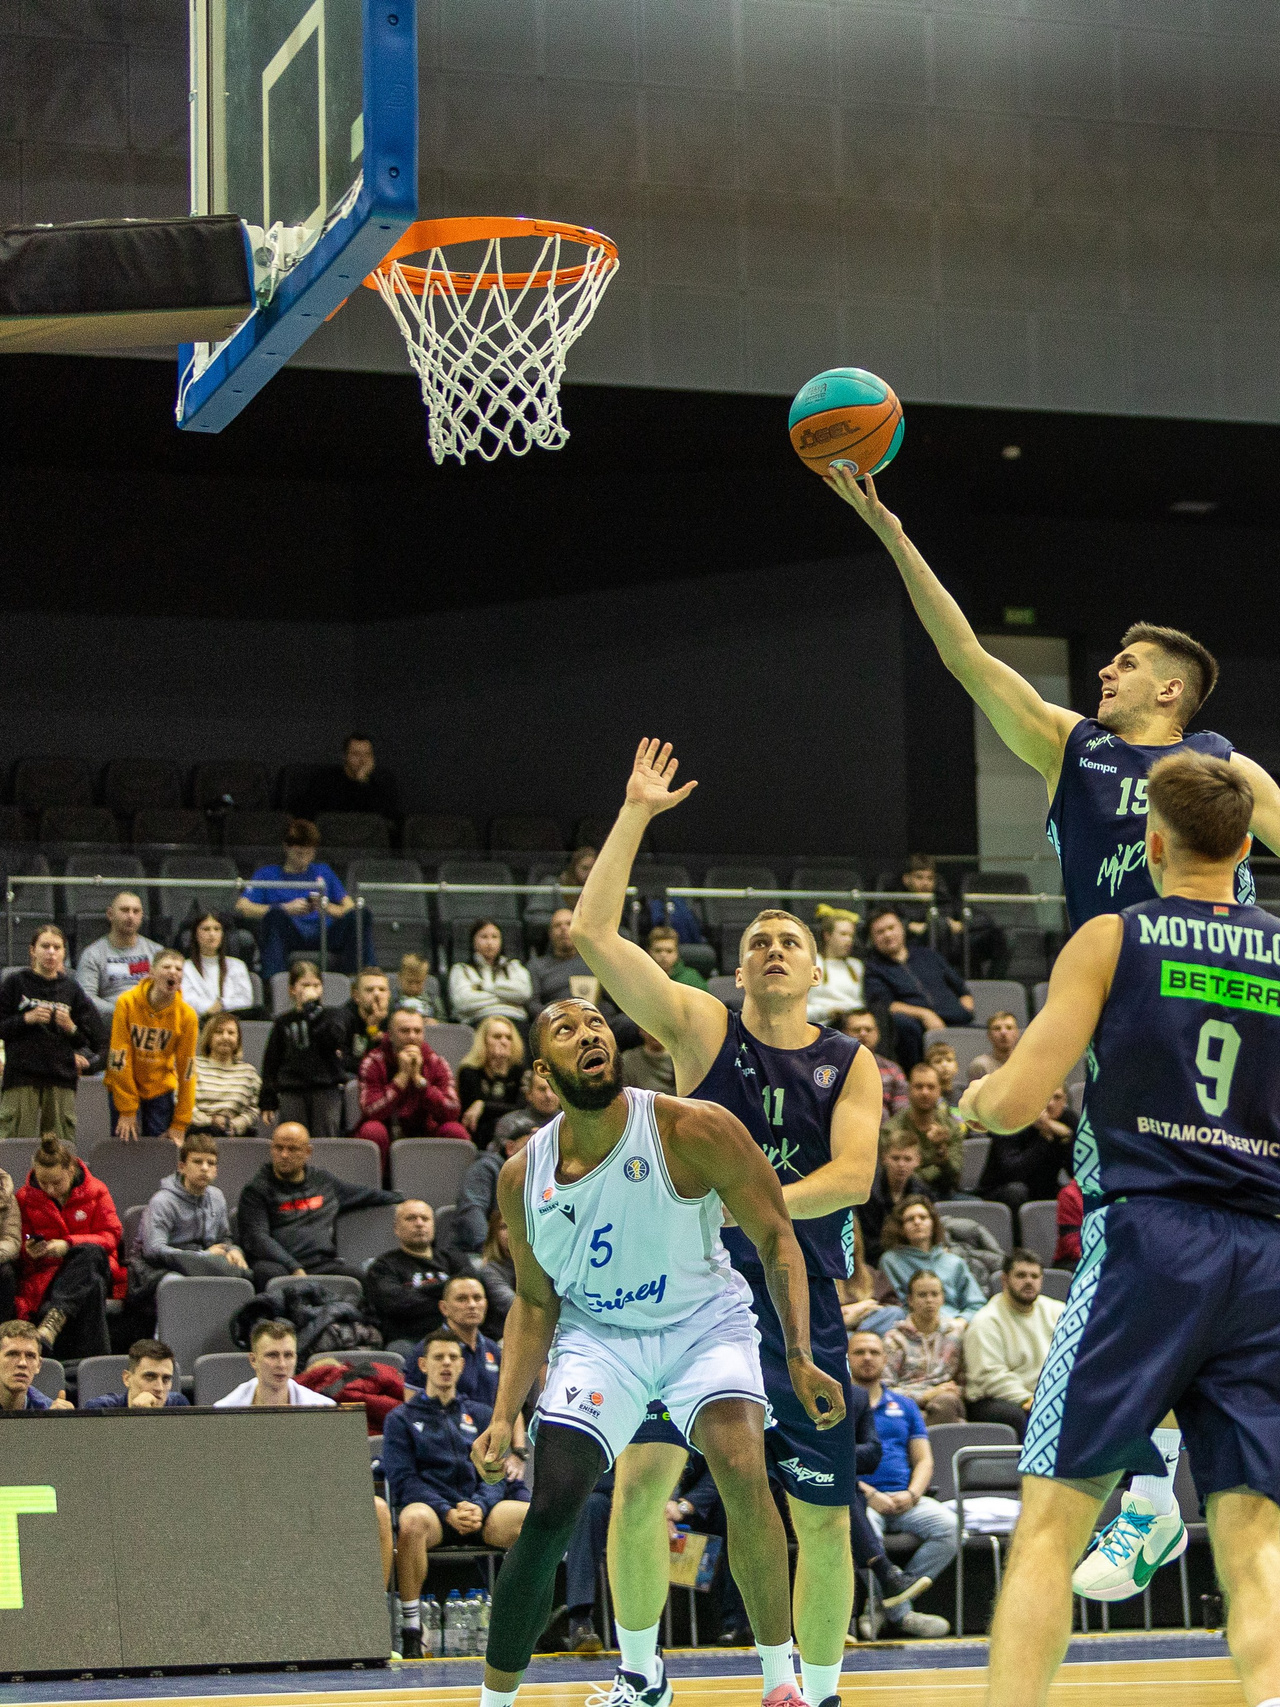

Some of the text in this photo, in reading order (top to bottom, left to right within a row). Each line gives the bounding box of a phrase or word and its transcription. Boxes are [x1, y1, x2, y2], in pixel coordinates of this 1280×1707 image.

[1079, 757, 1117, 774] Kempa
[1116, 777, 1150, 815] 15
[1195, 1018, 1242, 1117] 9
[762, 1085, 785, 1126] 11
[589, 1222, 613, 1268] 5
[583, 1274, 667, 1313] Enisey
[579, 1404, 602, 1417] ENISEY
